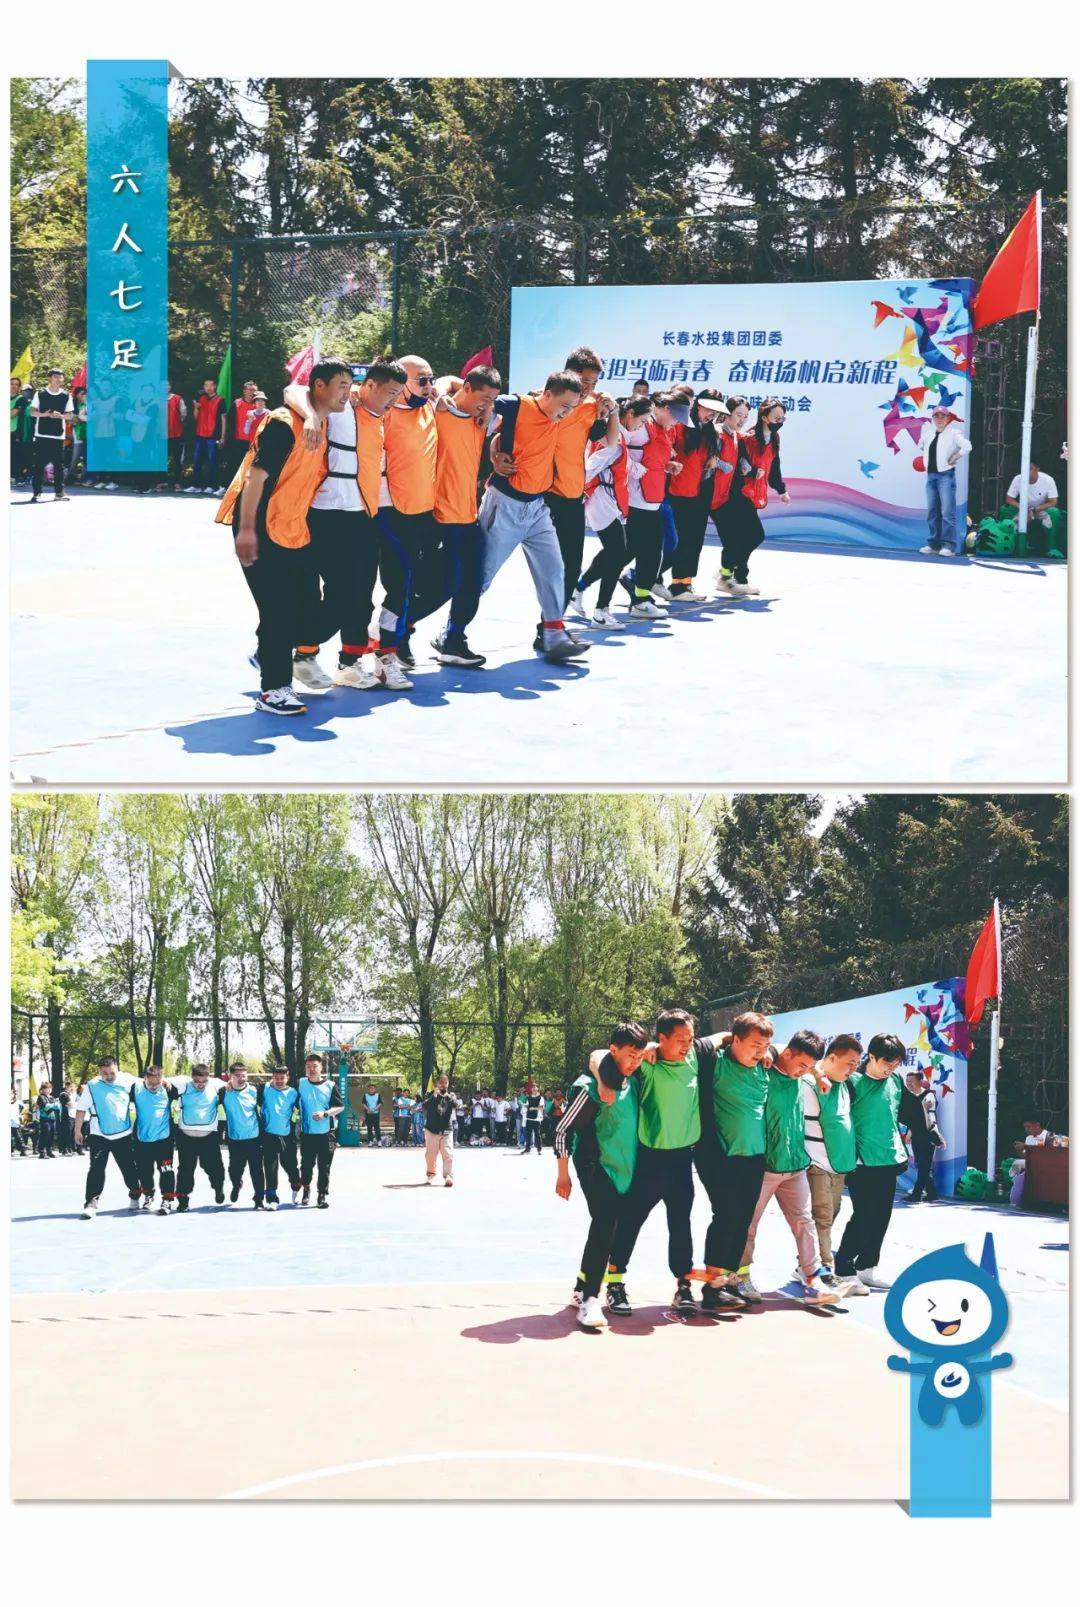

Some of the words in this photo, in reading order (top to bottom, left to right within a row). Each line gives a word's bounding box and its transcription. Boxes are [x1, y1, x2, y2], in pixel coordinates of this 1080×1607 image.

[662, 330, 783, 347] 长春水投集团团委
[728, 358, 898, 385] 奋楫扬帆启新程
